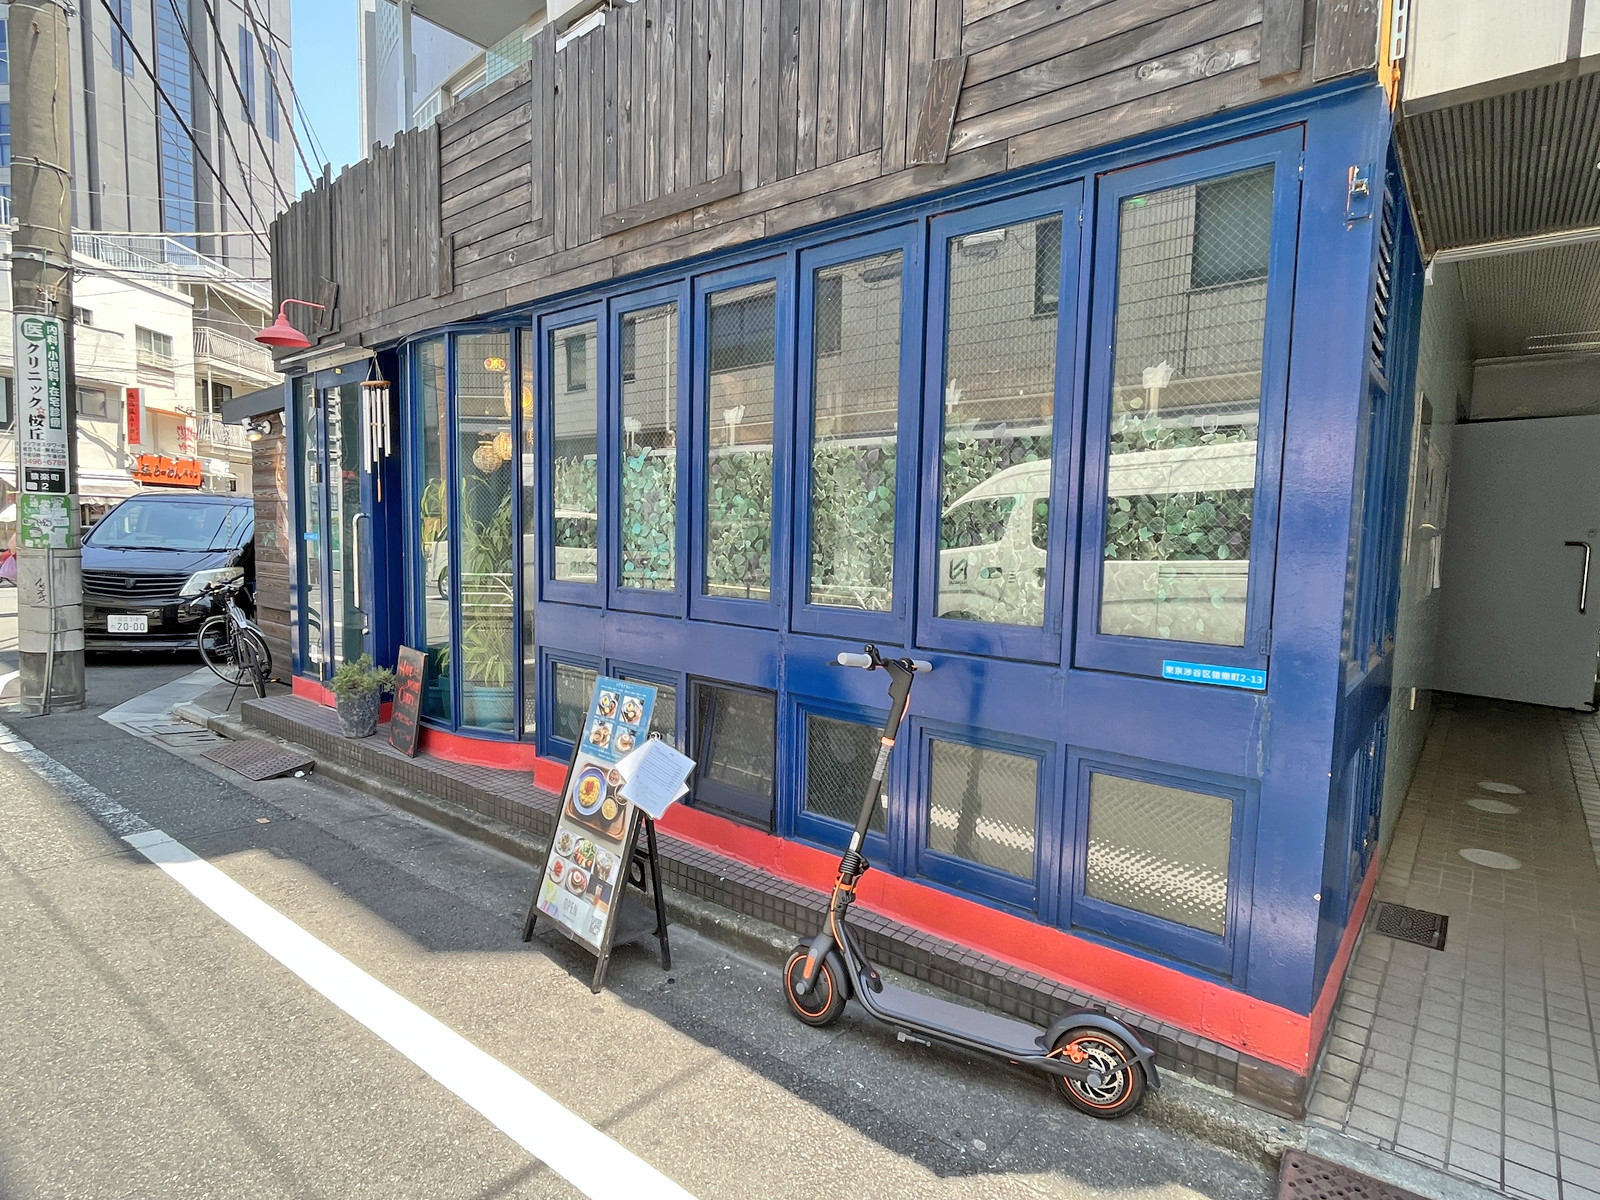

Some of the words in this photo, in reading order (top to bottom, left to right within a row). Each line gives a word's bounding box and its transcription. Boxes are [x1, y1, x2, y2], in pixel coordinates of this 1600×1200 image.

[23, 320, 44, 338] 医
[23, 458, 67, 466] 3496-6789
[41, 482, 50, 491] 2
[117, 622, 145, 631] 20-00
